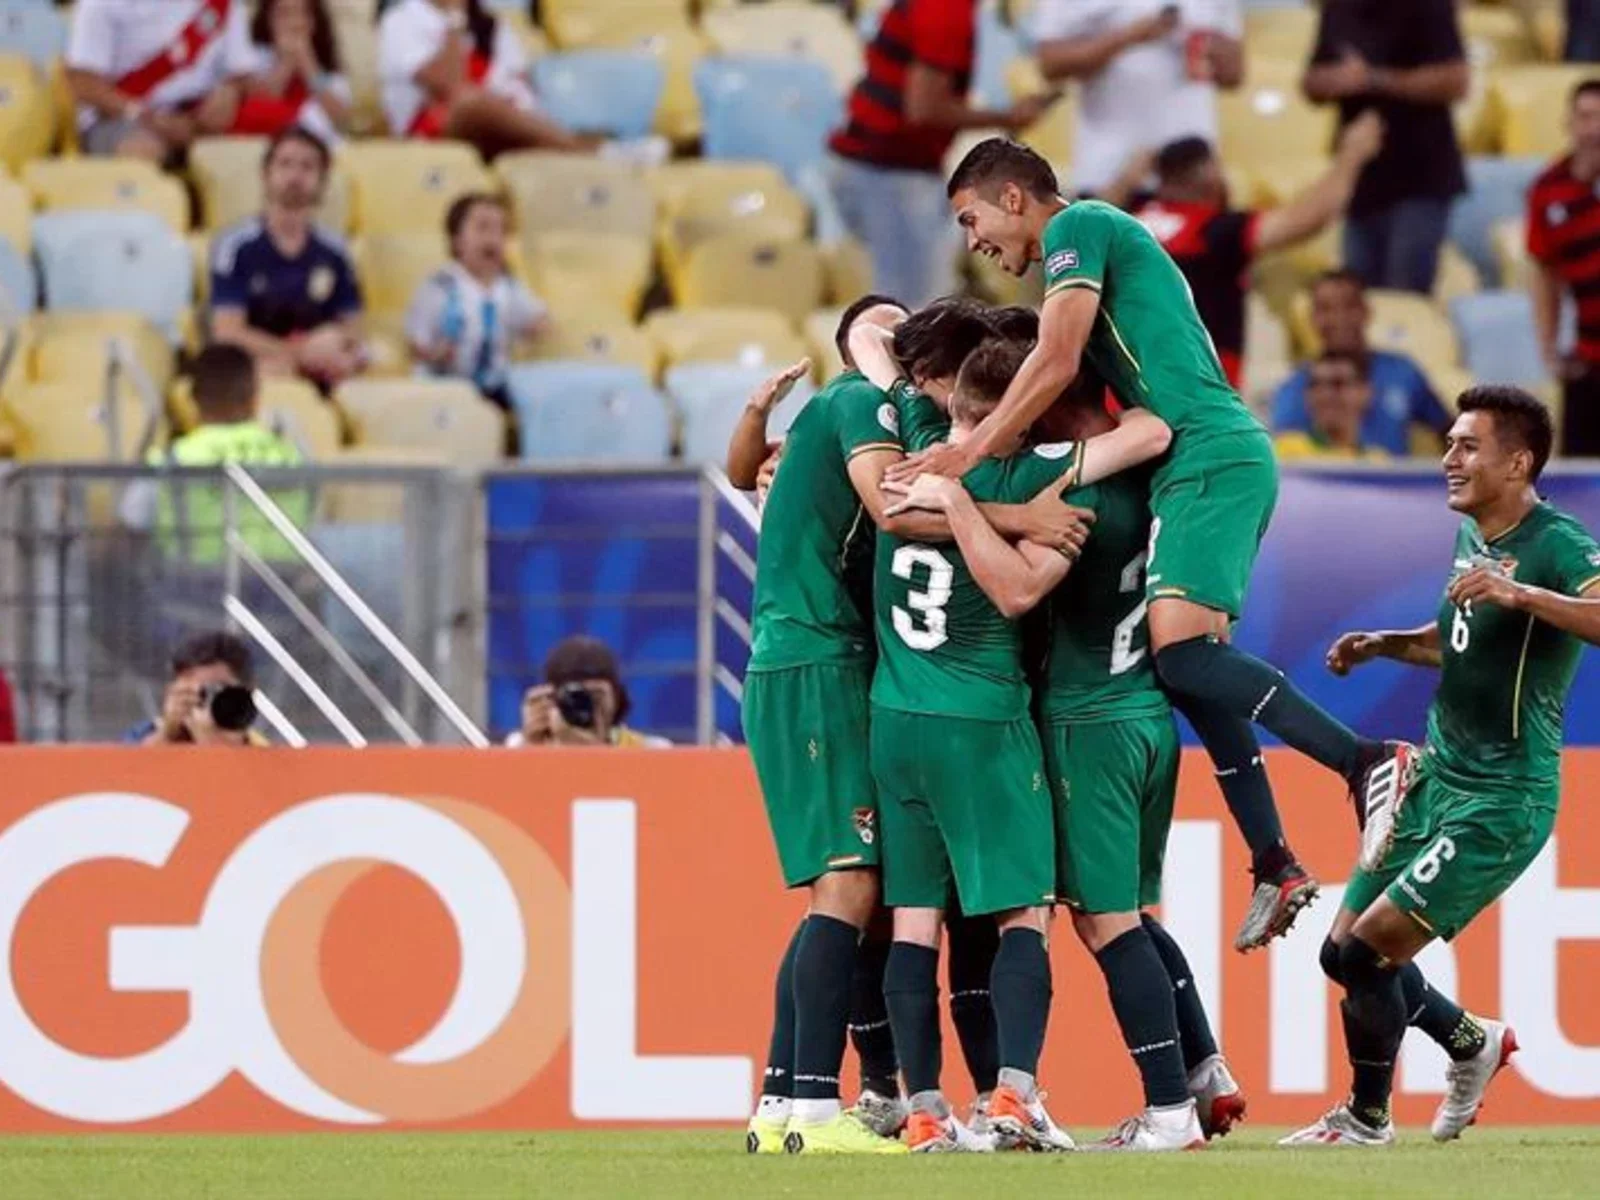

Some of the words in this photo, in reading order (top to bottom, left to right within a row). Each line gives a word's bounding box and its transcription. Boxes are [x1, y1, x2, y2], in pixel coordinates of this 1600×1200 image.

[891, 544, 954, 651] 3
[1451, 598, 1473, 653] 6
[1412, 836, 1457, 884] 6
[0, 792, 753, 1123] GOL
